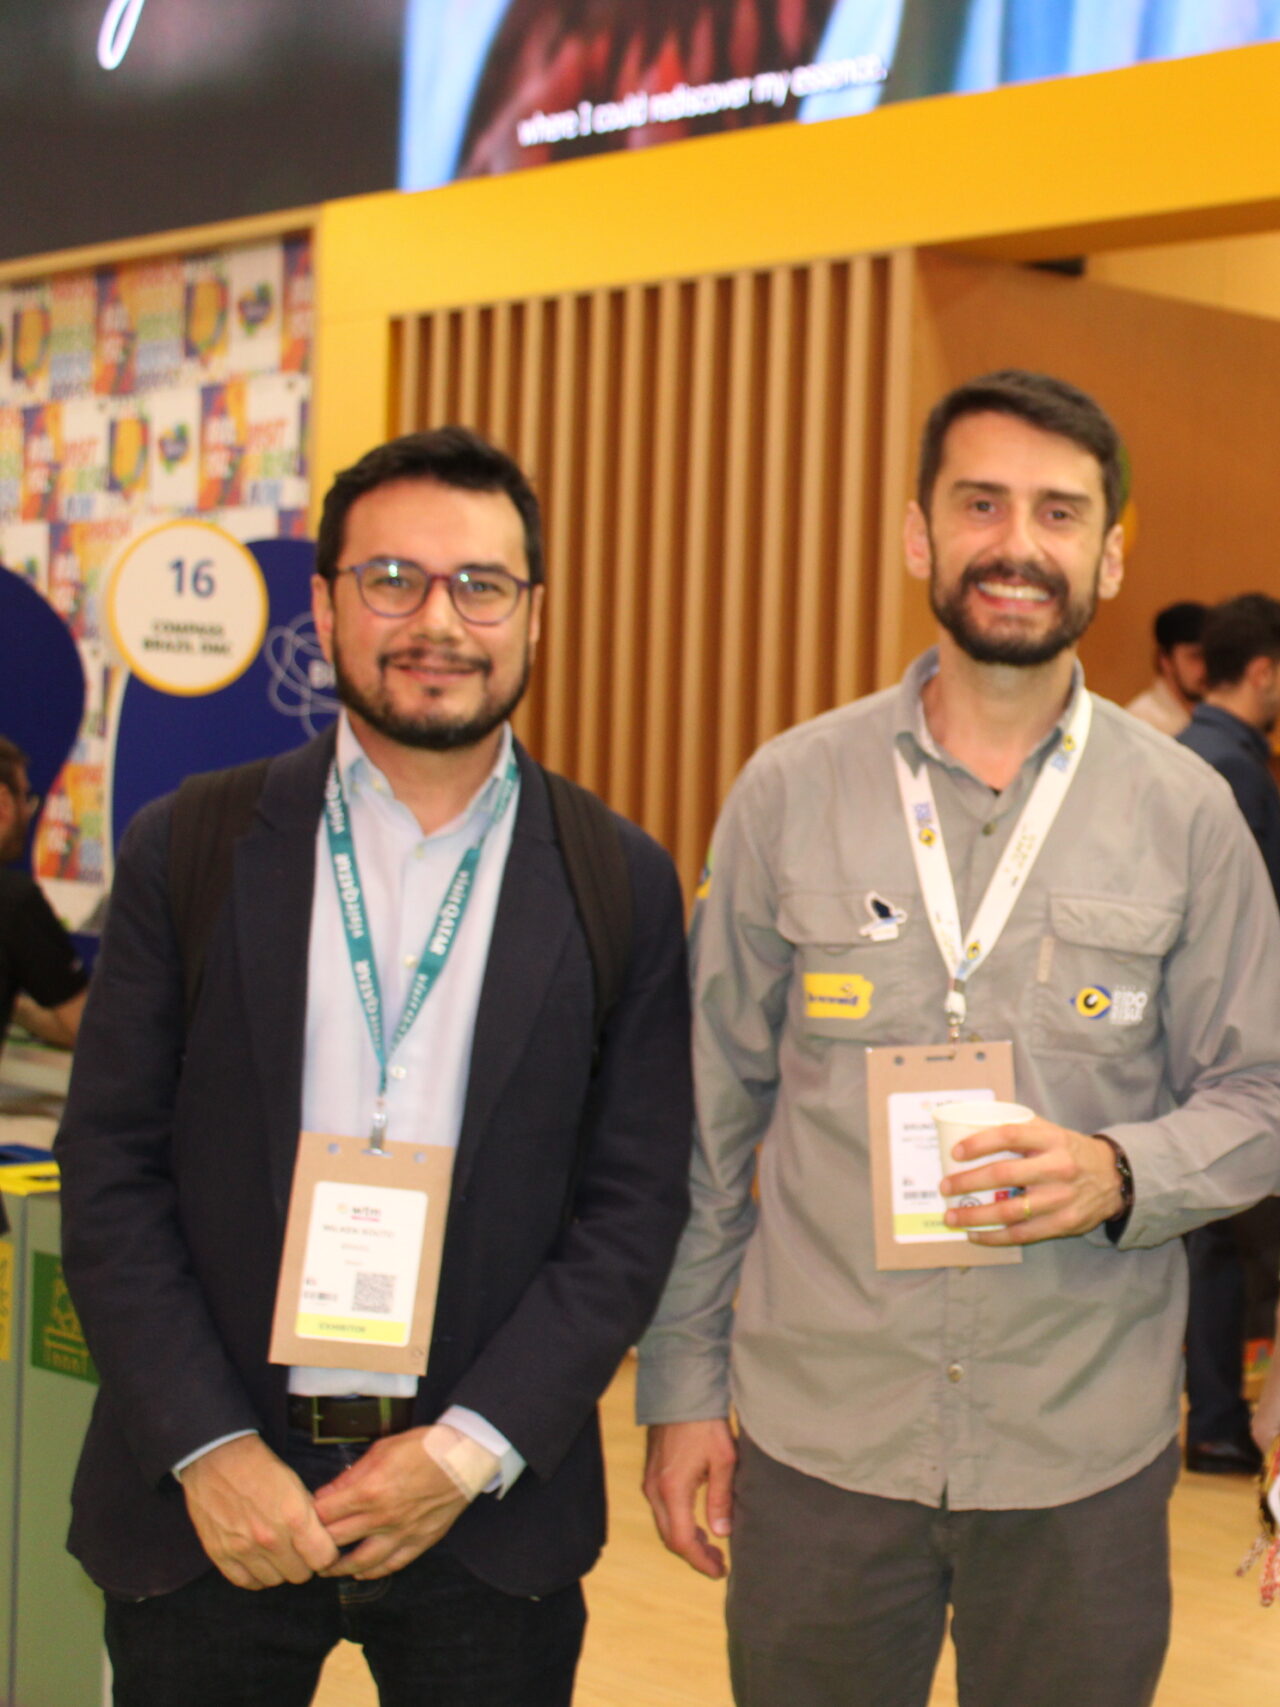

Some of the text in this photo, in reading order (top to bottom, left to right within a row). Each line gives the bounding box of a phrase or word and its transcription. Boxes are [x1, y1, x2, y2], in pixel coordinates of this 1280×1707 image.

[518, 111, 578, 146] where
[592, 90, 648, 134] could
[649, 77, 750, 122] rediscover
[751, 71, 790, 107] my
[169, 557, 216, 600] 16
[334, 853, 363, 939] visitQATAR
[430, 870, 470, 955] visitQATAR
